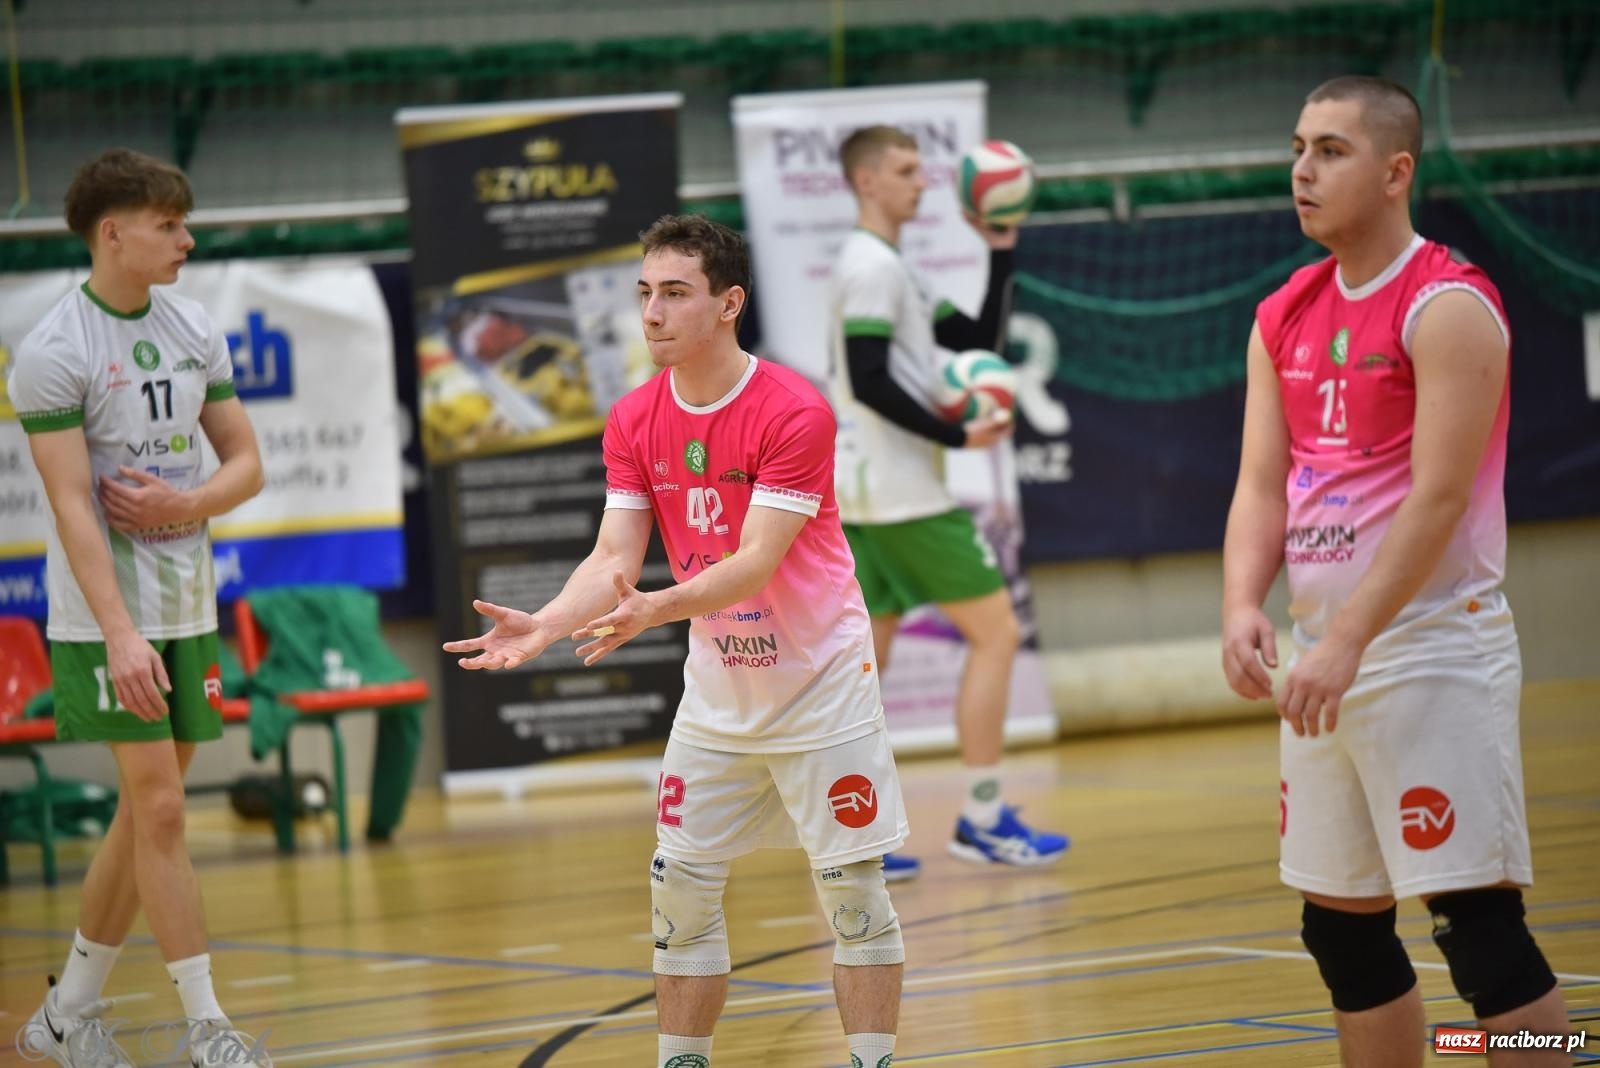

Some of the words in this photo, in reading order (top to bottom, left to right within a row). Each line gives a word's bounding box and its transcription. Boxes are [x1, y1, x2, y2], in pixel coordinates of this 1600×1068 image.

[141, 380, 172, 421] 17
[687, 487, 729, 536] 42
[712, 633, 777, 656] VEXIN
[657, 771, 687, 828] 2
